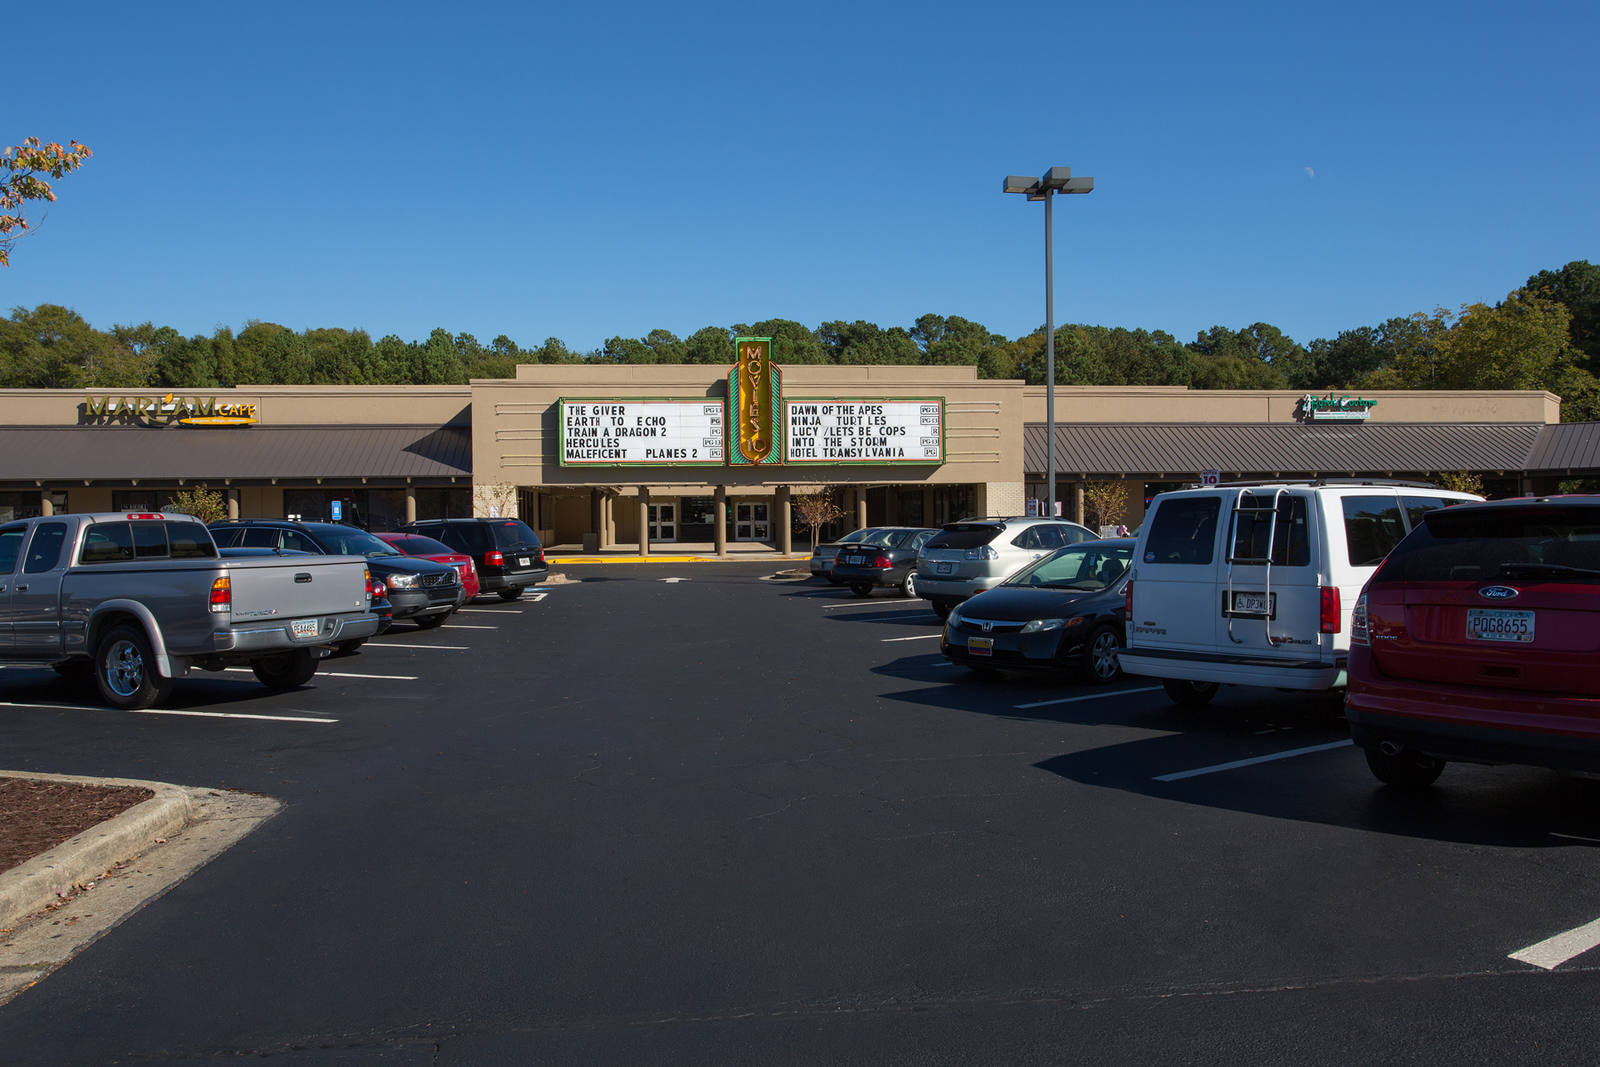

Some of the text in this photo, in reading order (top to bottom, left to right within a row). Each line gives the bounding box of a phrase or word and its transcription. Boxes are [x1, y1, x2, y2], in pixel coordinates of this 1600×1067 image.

[747, 346, 767, 452] MOVIES 10
[218, 403, 256, 416] CAFE
[569, 406, 625, 415] THE GIVER
[792, 406, 883, 415] DAWN OF THE APES
[567, 417, 666, 426] EARTH TO ECHO
[791, 416, 887, 426] NINJA TURTLES
[567, 427, 667, 437] TRAIN A DRAGON 2
[792, 427, 819, 436] LUCY
[858, 427, 871, 436] BE
[879, 427, 906, 436] COPS
[566, 438, 620, 448] HERCULES
[792, 437, 887, 447] INTO THE STORM
[566, 448, 698, 459] MALEFICENT PLANES 2
[790, 447, 905, 458] HOTEL TRANSYLVANIA
[1486, 588, 1508, 597] Ford
